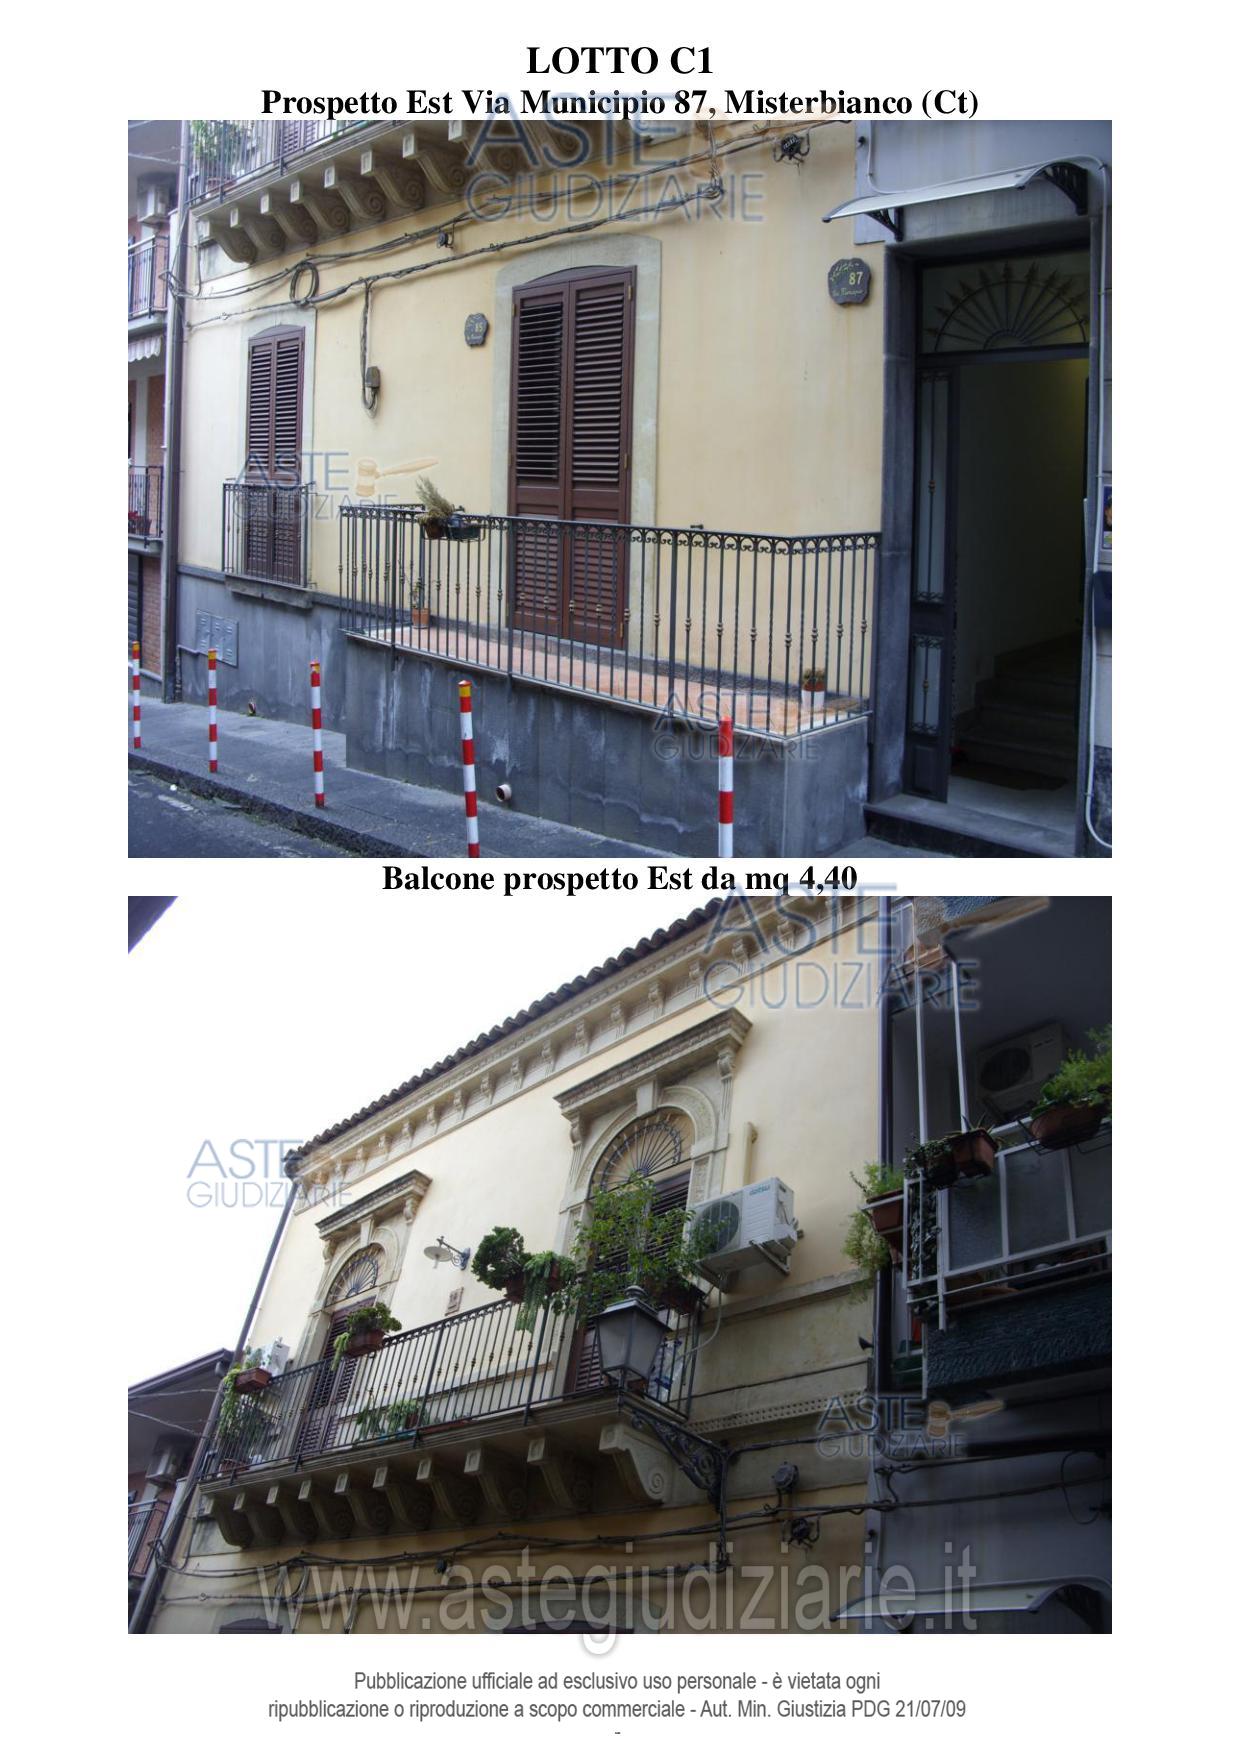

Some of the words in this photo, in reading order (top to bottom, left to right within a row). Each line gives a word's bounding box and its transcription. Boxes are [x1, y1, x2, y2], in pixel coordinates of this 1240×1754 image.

[527, 46, 659, 75] LOTTO
[671, 46, 713, 75] C1
[262, 90, 398, 120] Prospetto
[407, 90, 453, 114] Est
[463, 90, 510, 114] Via
[520, 90, 666, 120] Municipio
[675, 90, 716, 119] 87,
[725, 89, 913, 114] Misterbianco
[922, 89, 978, 119] (Ct)
[849, 271, 863, 285] 87
[383, 866, 495, 890] Balcone
[504, 868, 639, 897] prospetto
[648, 866, 693, 890] Est
[702, 866, 737, 890] da
[745, 872, 790, 897] mq
[799, 866, 858, 895] 4,40
